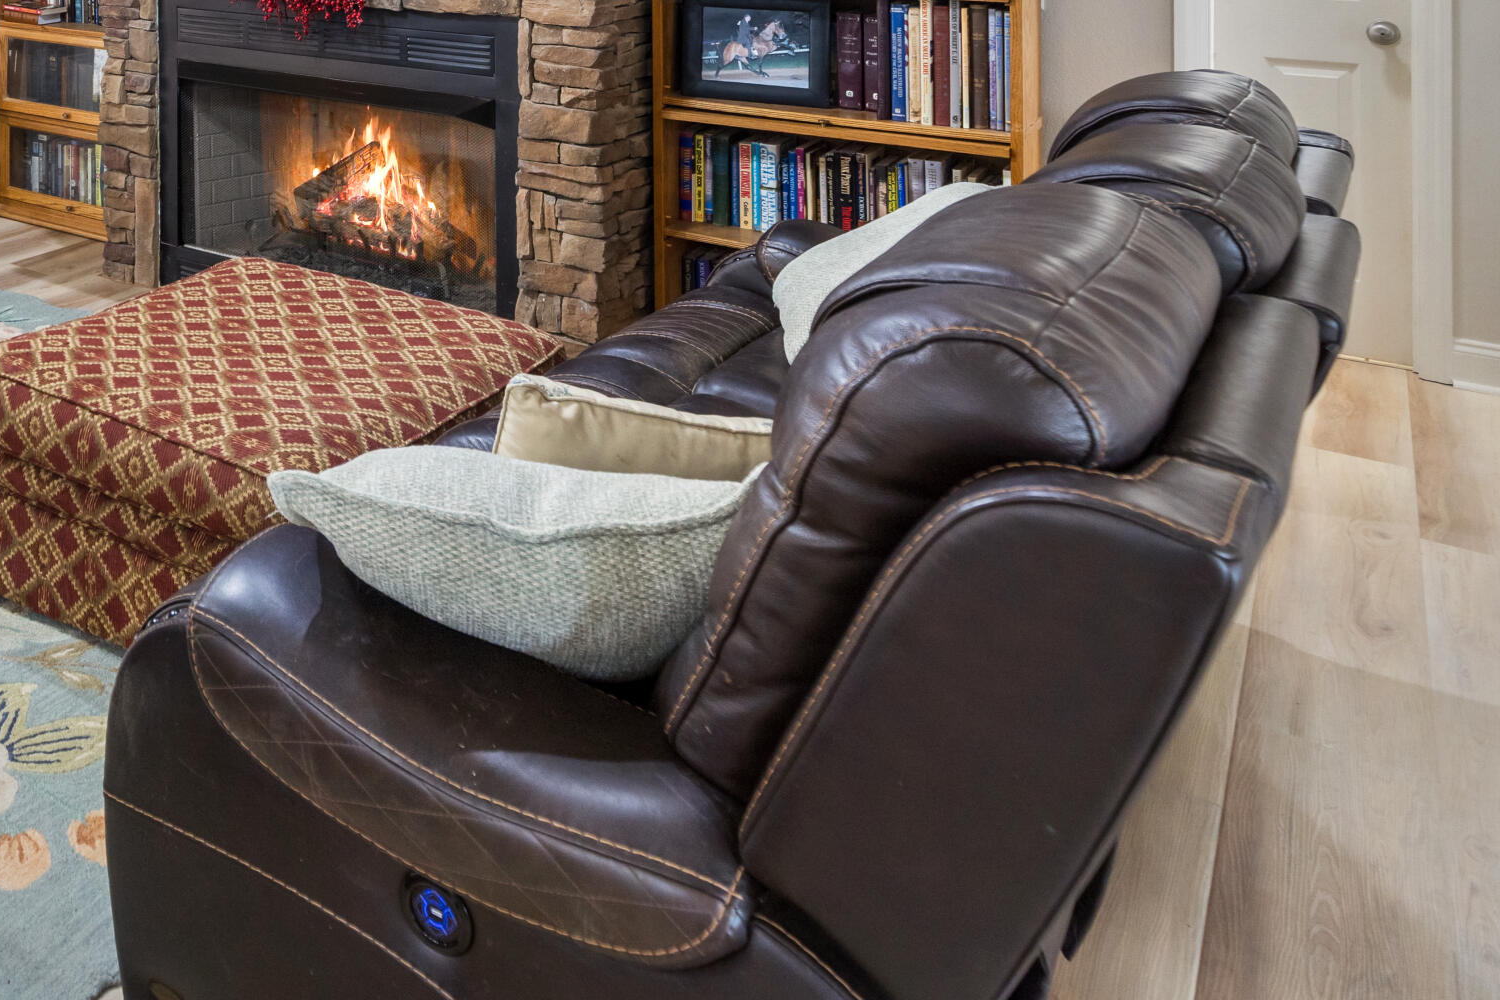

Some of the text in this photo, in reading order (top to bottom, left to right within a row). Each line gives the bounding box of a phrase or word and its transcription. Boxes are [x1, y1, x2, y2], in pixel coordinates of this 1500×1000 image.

[740, 144, 750, 169] CHRISTIAN
[760, 147, 768, 184] CUSSLER
[768, 154, 776, 180] CLIVE
[840, 156, 851, 173] FRANK
[840, 173, 851, 195] PERETTI
[760, 195, 768, 222] FOUND
[767, 192, 776, 228] ATLANTI
